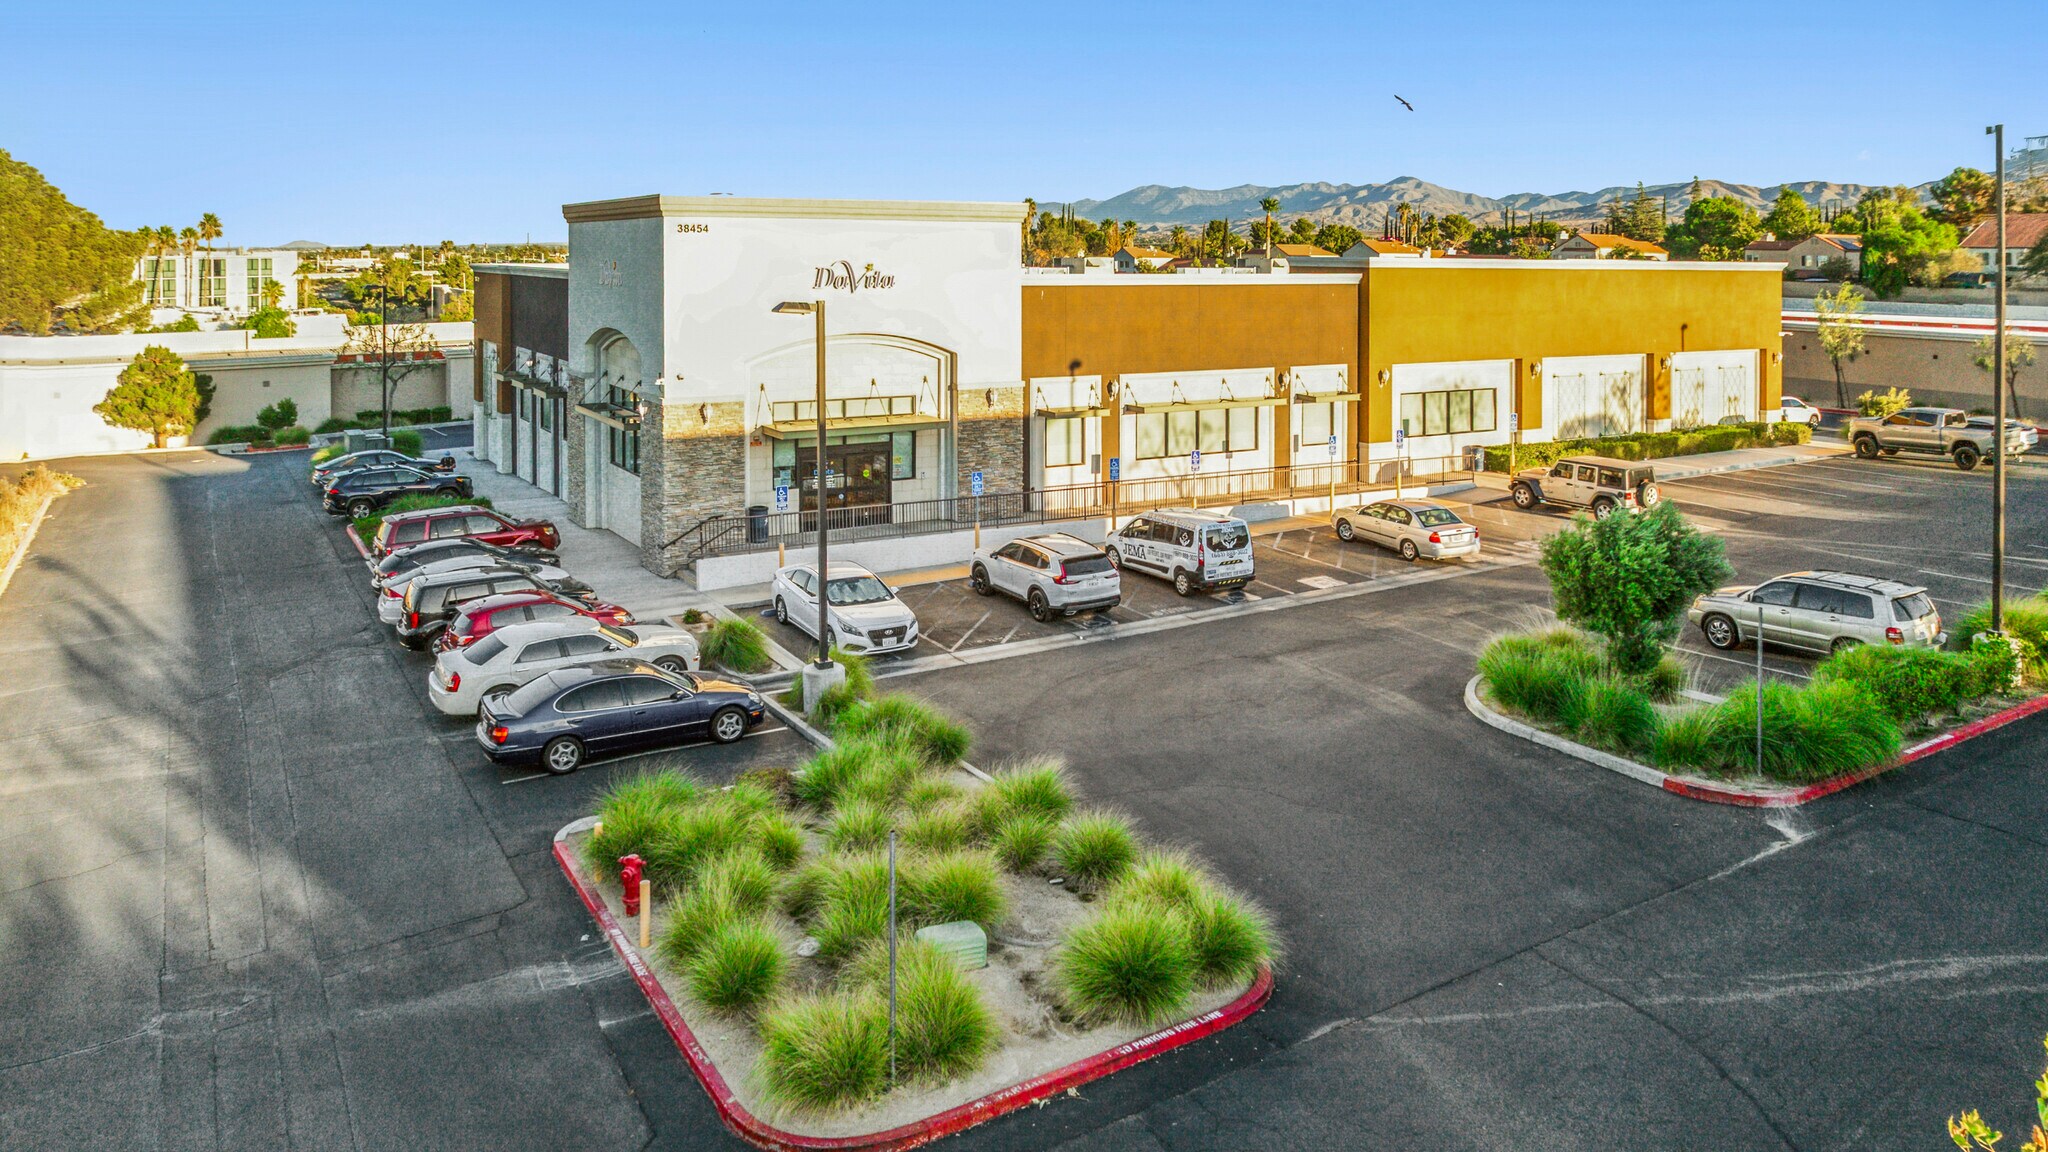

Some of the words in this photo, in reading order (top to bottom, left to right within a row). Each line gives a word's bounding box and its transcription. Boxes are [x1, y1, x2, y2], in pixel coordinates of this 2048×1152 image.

[677, 224, 709, 234] 38454
[812, 259, 896, 294] DaVita
[1123, 543, 1147, 560] JEMA
[1132, 1029, 1176, 1050] PARKING
[1173, 1019, 1199, 1033] FIRE
[1197, 1010, 1224, 1023] LANE
